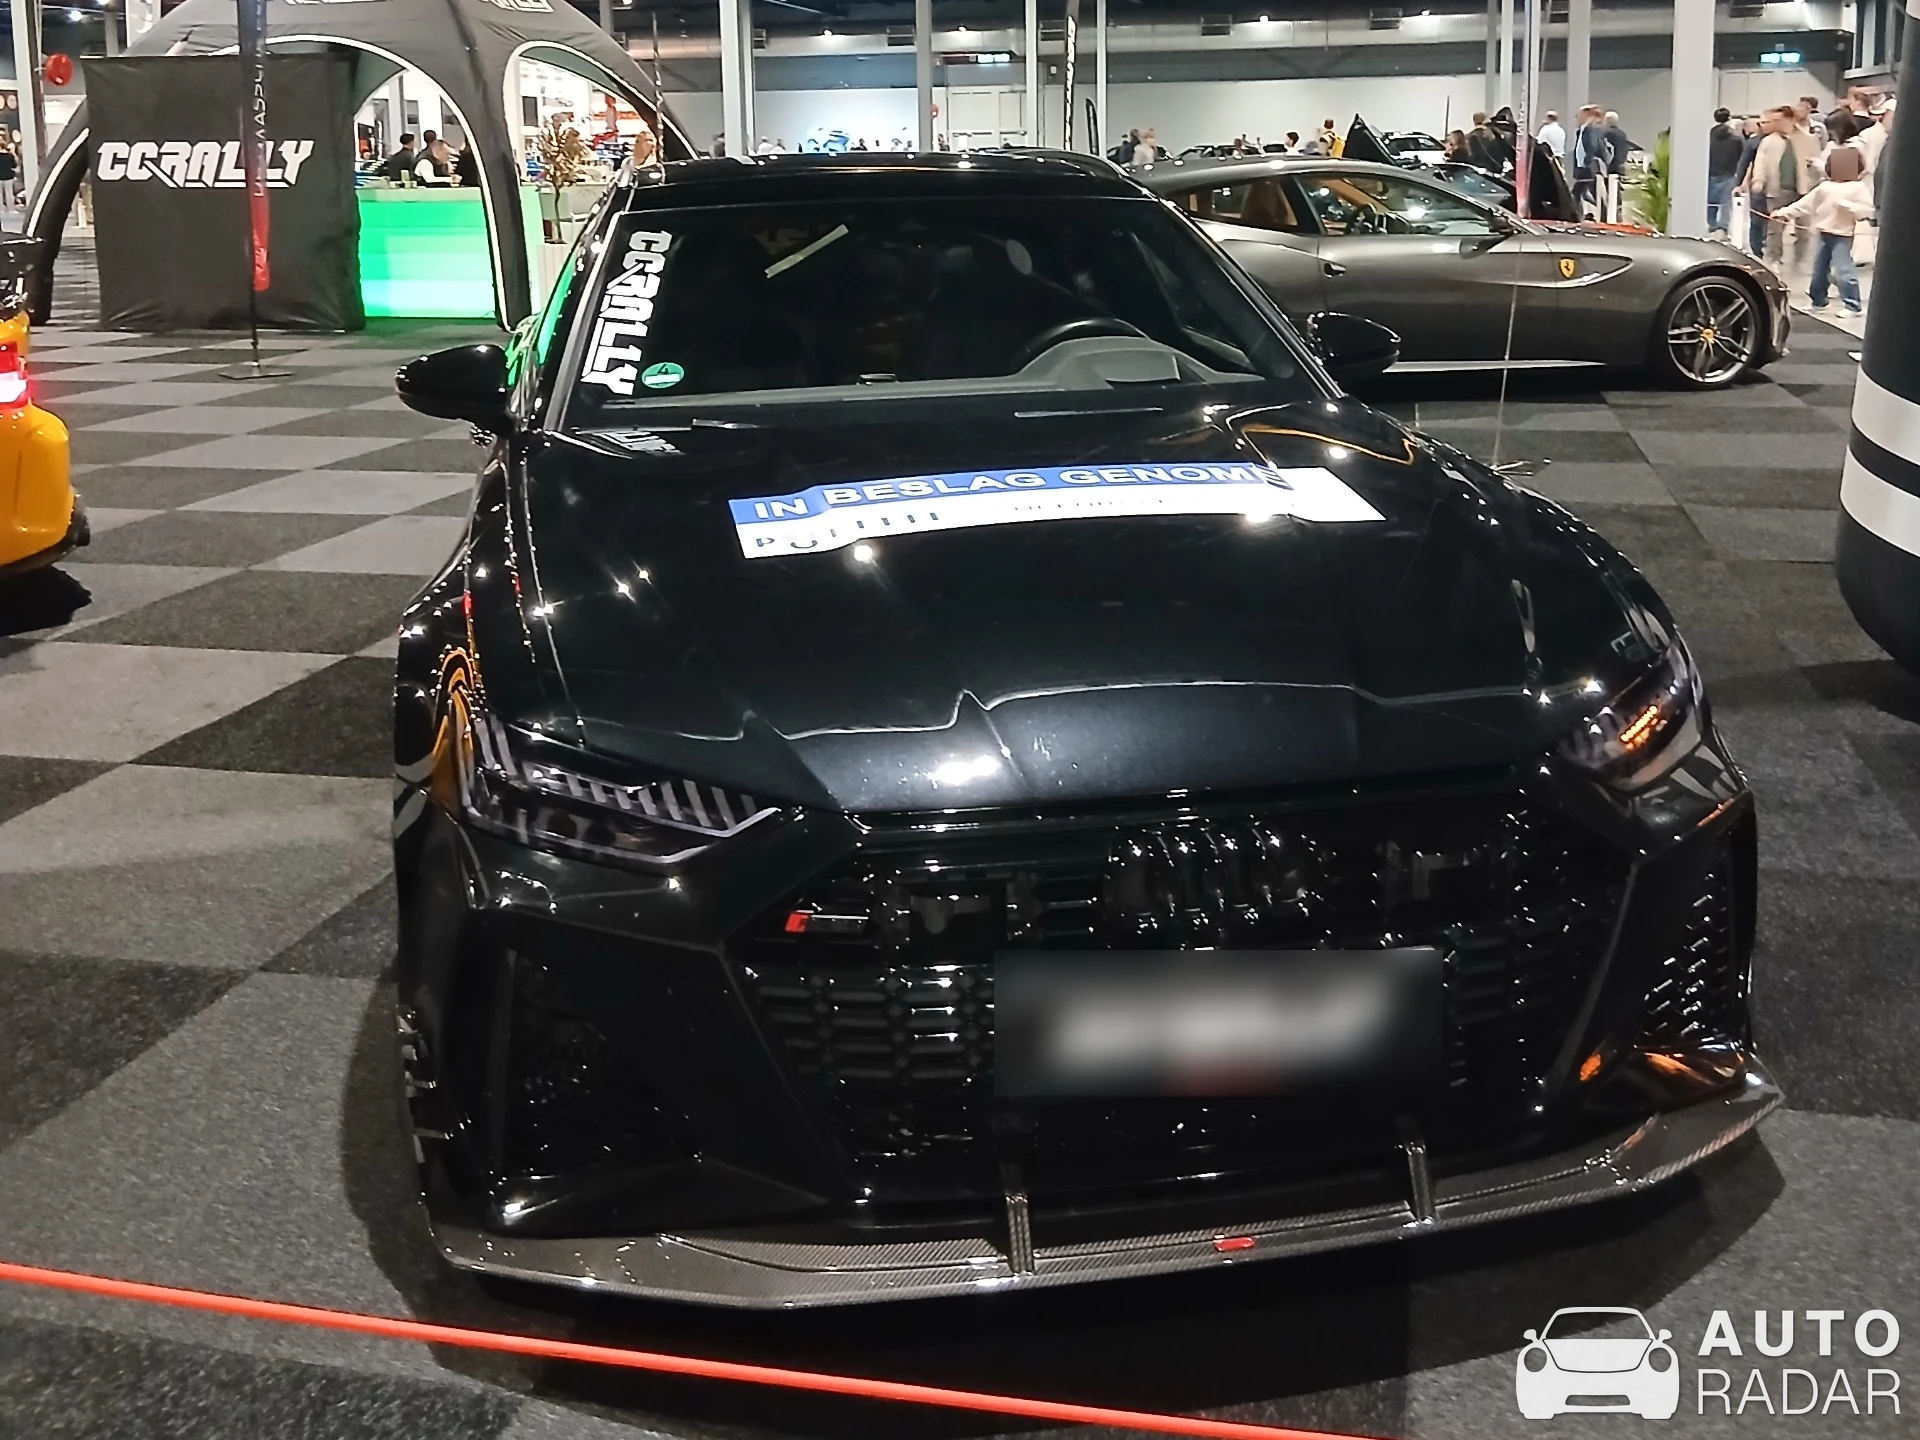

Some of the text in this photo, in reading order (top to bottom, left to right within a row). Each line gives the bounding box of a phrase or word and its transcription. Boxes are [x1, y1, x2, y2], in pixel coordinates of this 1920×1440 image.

[657, 363, 670, 375] 4
[753, 498, 809, 520] IN
[822, 471, 1047, 506] BESLAG
